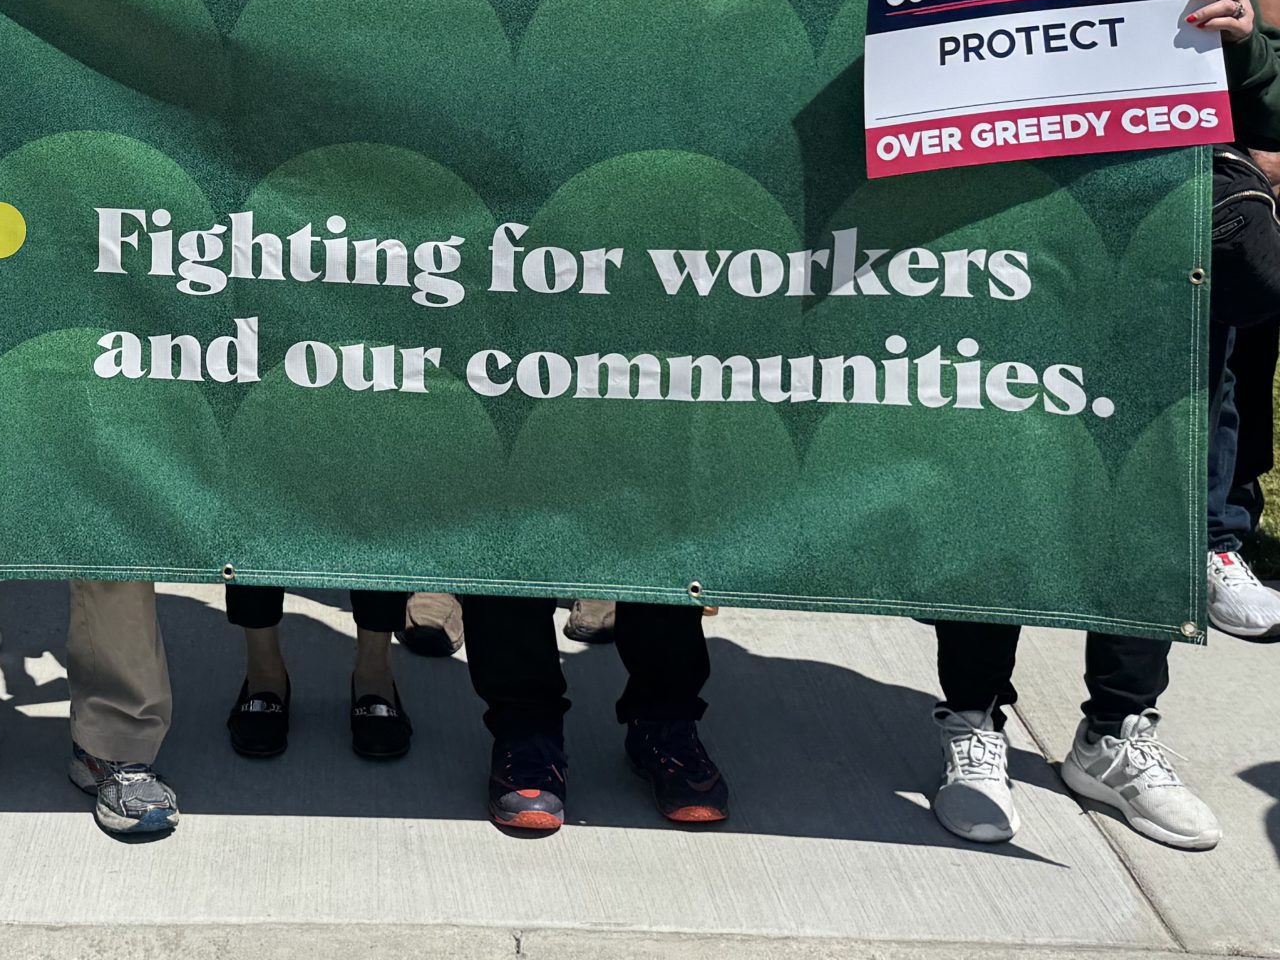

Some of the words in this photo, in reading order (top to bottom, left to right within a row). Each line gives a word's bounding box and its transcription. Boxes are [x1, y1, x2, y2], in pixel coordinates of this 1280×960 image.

[939, 17, 1125, 66] PROTECT
[876, 127, 963, 161] OVER
[970, 110, 1112, 148] GREEDY
[1121, 104, 1218, 134] CEOs
[93, 207, 466, 308] Fighting
[487, 222, 624, 296] for
[647, 226, 1033, 301] workers
[93, 316, 262, 384] and
[284, 340, 442, 395] our
[466, 335, 1115, 418] communities.
